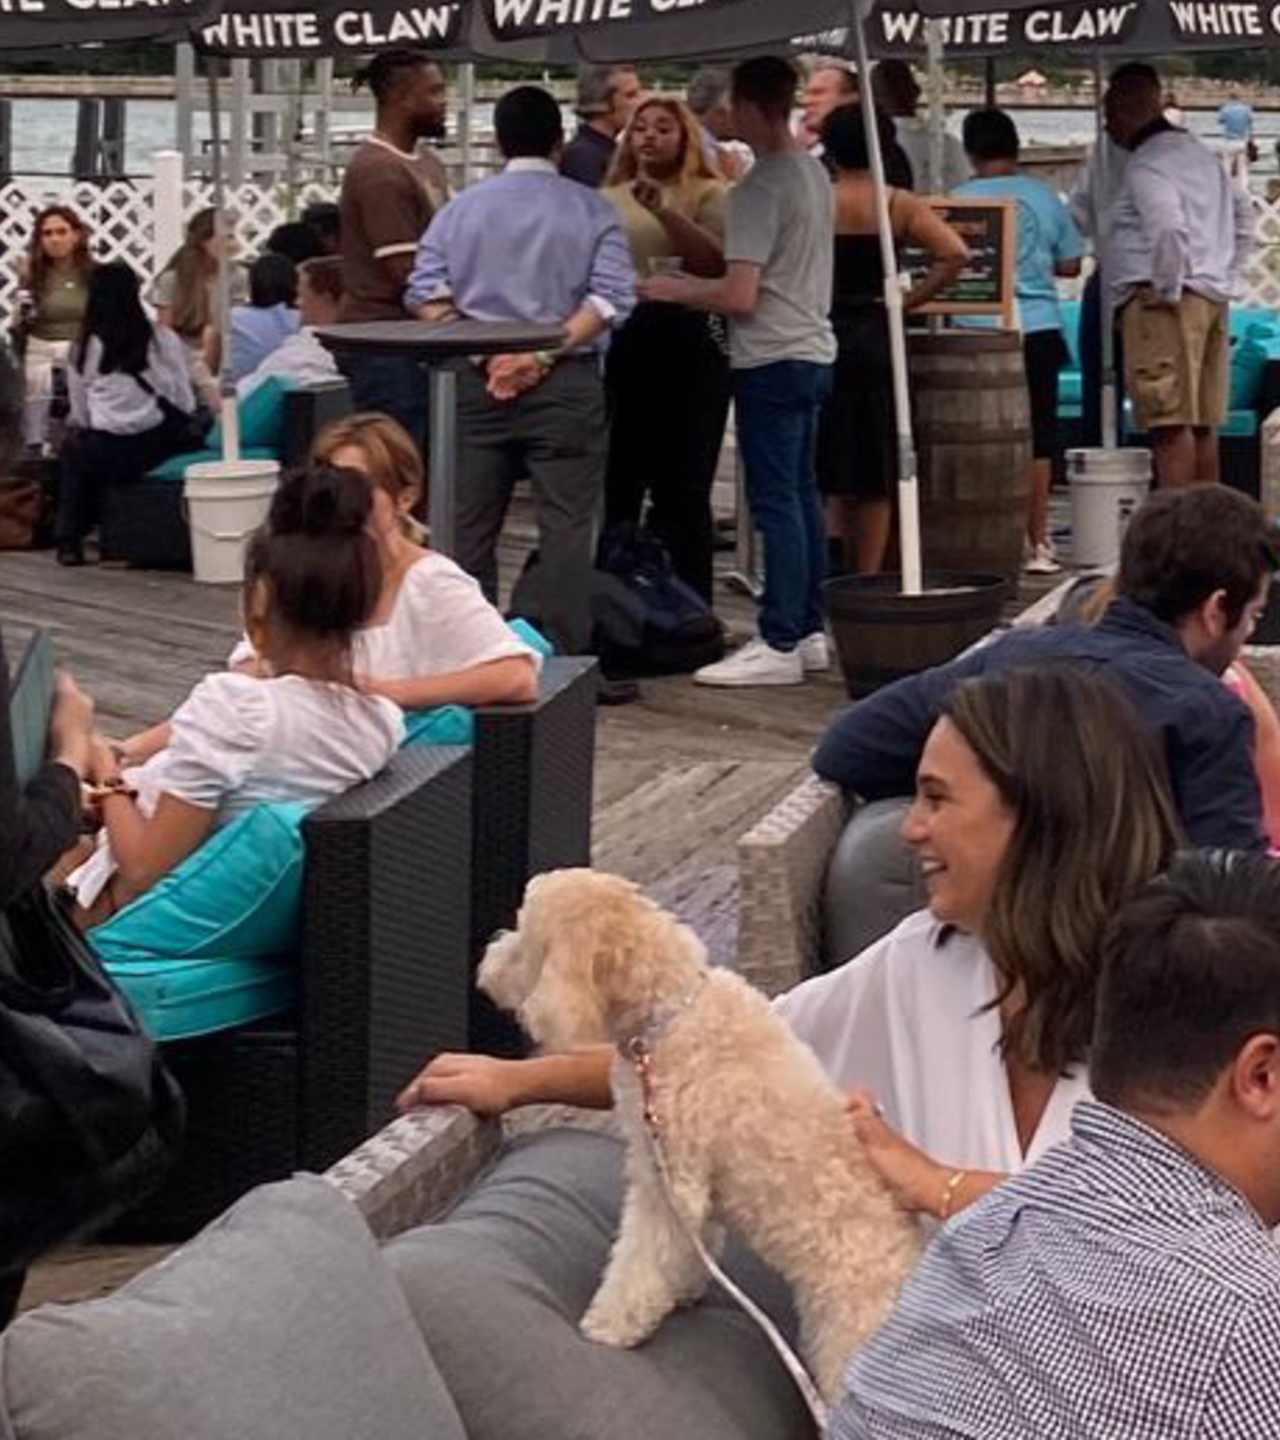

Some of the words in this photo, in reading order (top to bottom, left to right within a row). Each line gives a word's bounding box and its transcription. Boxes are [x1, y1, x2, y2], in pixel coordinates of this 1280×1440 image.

[334, 5, 450, 44] CLAW
[1025, 5, 1128, 43] CLAW
[1170, 1, 1264, 34] WHITE
